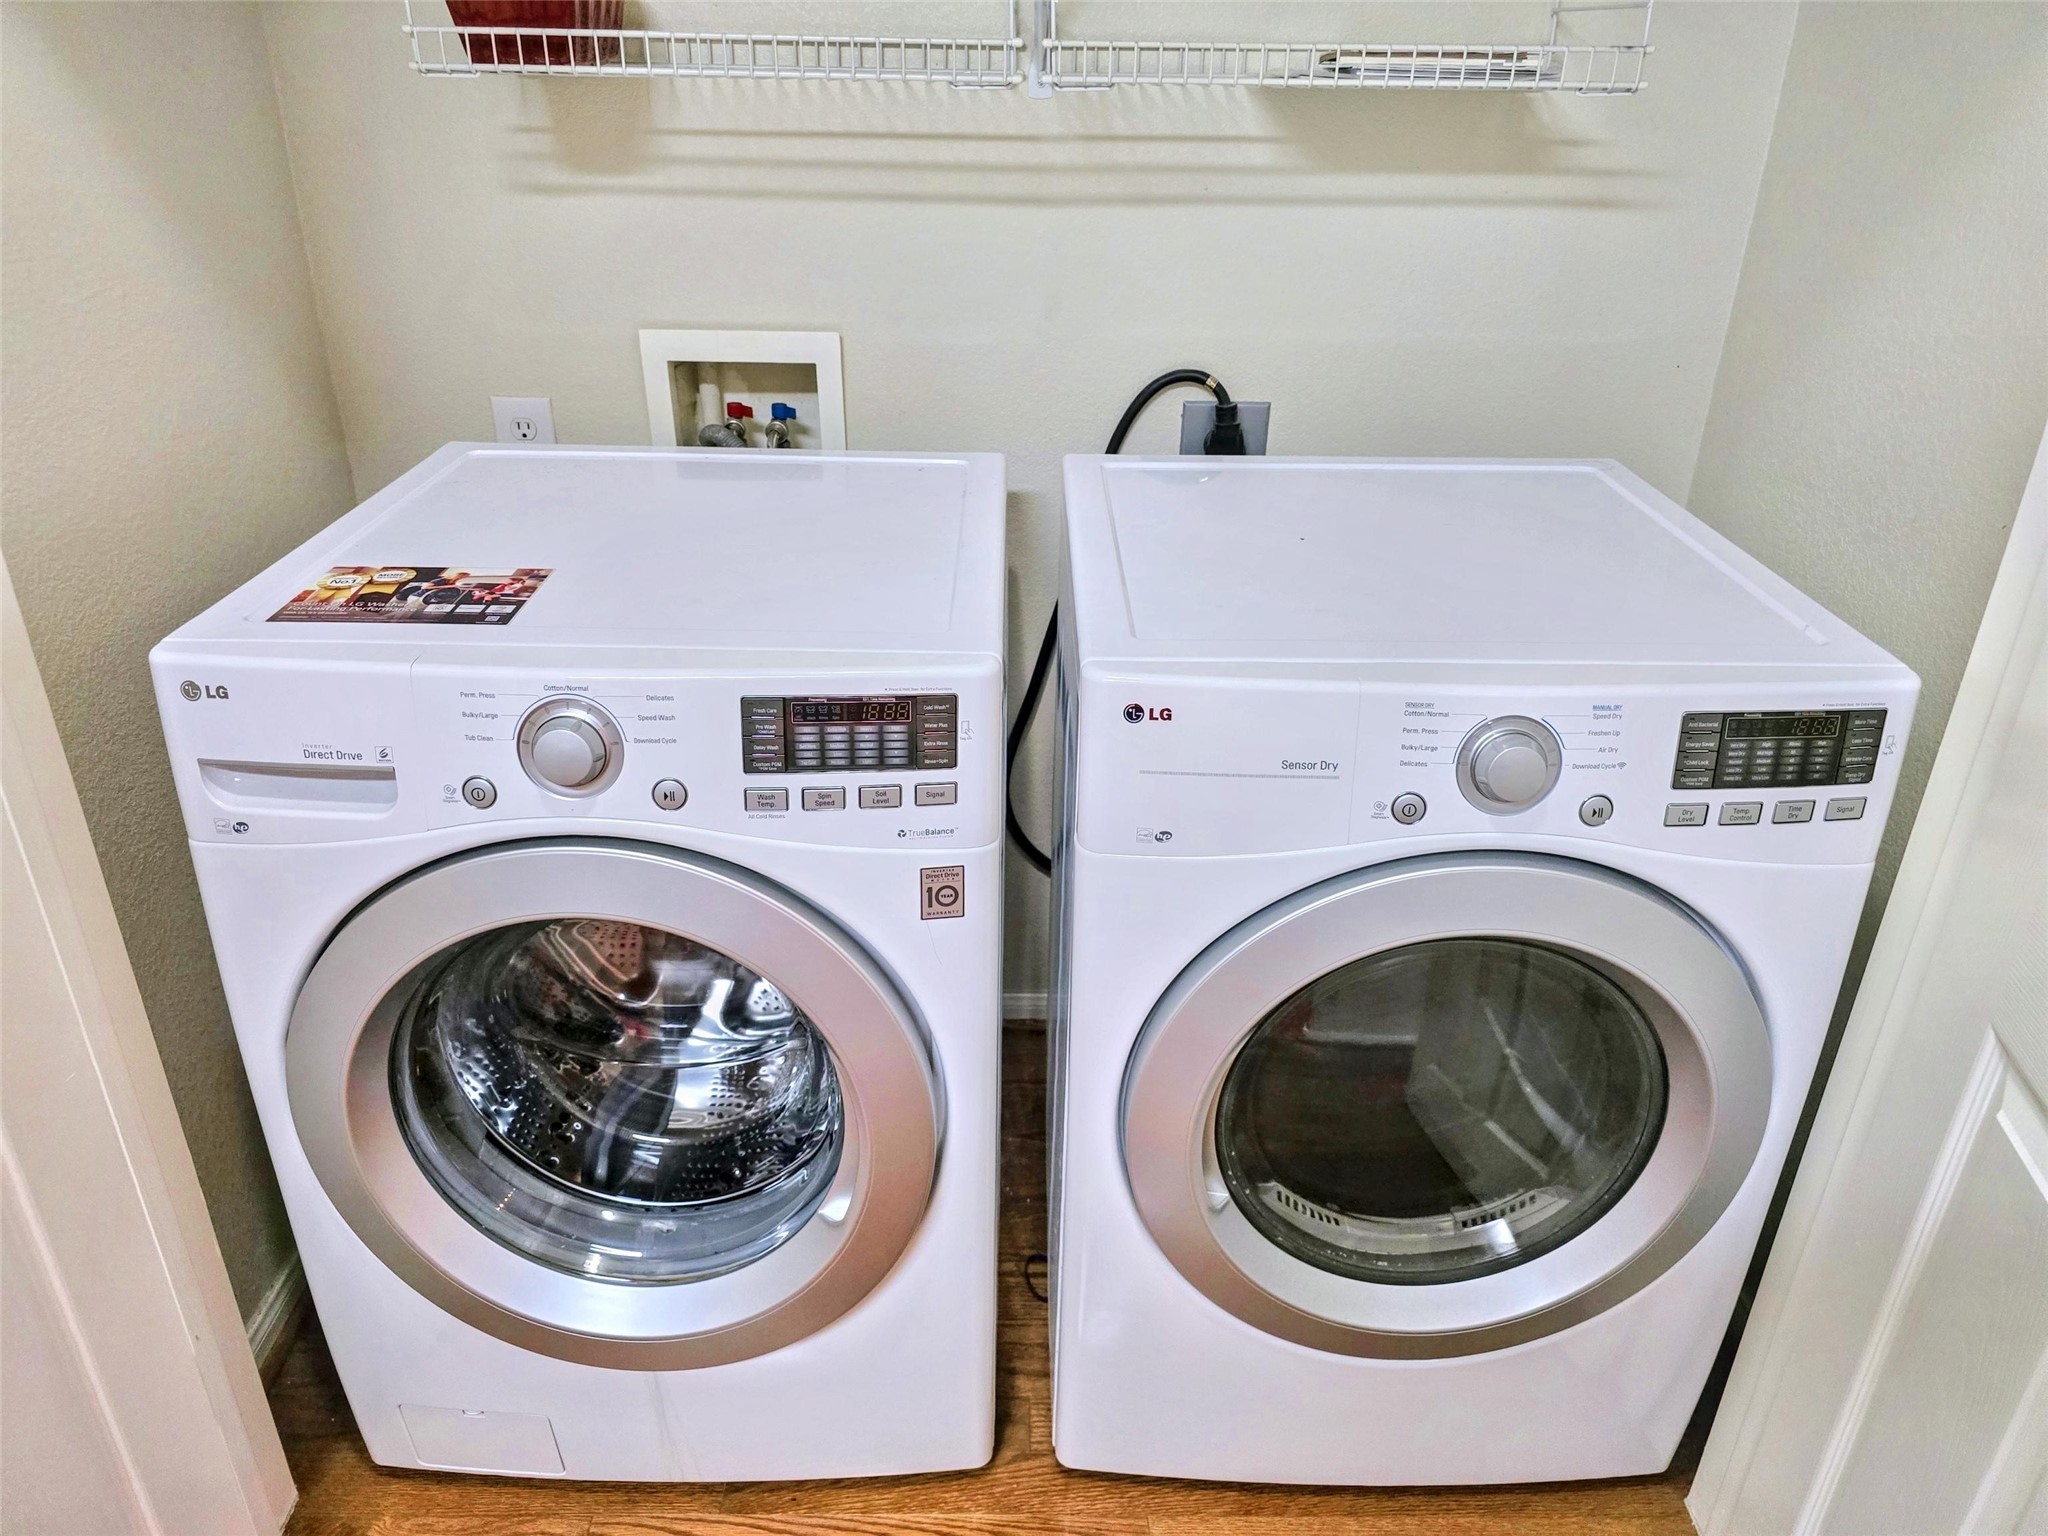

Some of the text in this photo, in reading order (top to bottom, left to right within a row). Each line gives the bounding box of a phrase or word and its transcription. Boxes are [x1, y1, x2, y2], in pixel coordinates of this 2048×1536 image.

[205, 685, 229, 699] LG
[462, 712, 498, 720] Bulky/Large
[638, 714, 656, 722] Speed
[1149, 708, 1172, 721] LG
[1404, 710, 1450, 718] Cotton/Normal
[1592, 713, 1623, 721] Speed Dry
[1612, 730, 1621, 738] Up
[660, 737, 677, 745] Cycle
[1401, 744, 1439, 752] Bulky/Large
[303, 749, 363, 760] Direct Drive
[1281, 759, 1339, 773] Sensor Dry
[1600, 762, 1617, 770] Cycle
[926, 791, 945, 799] Signal
[814, 800, 835, 808] Speed
[1682, 809, 1694, 817] Dry
[1836, 805, 1855, 813] Signal
[1729, 814, 1753, 822] Control
[1788, 812, 1799, 820] Dry
[927, 885, 959, 908] 10
